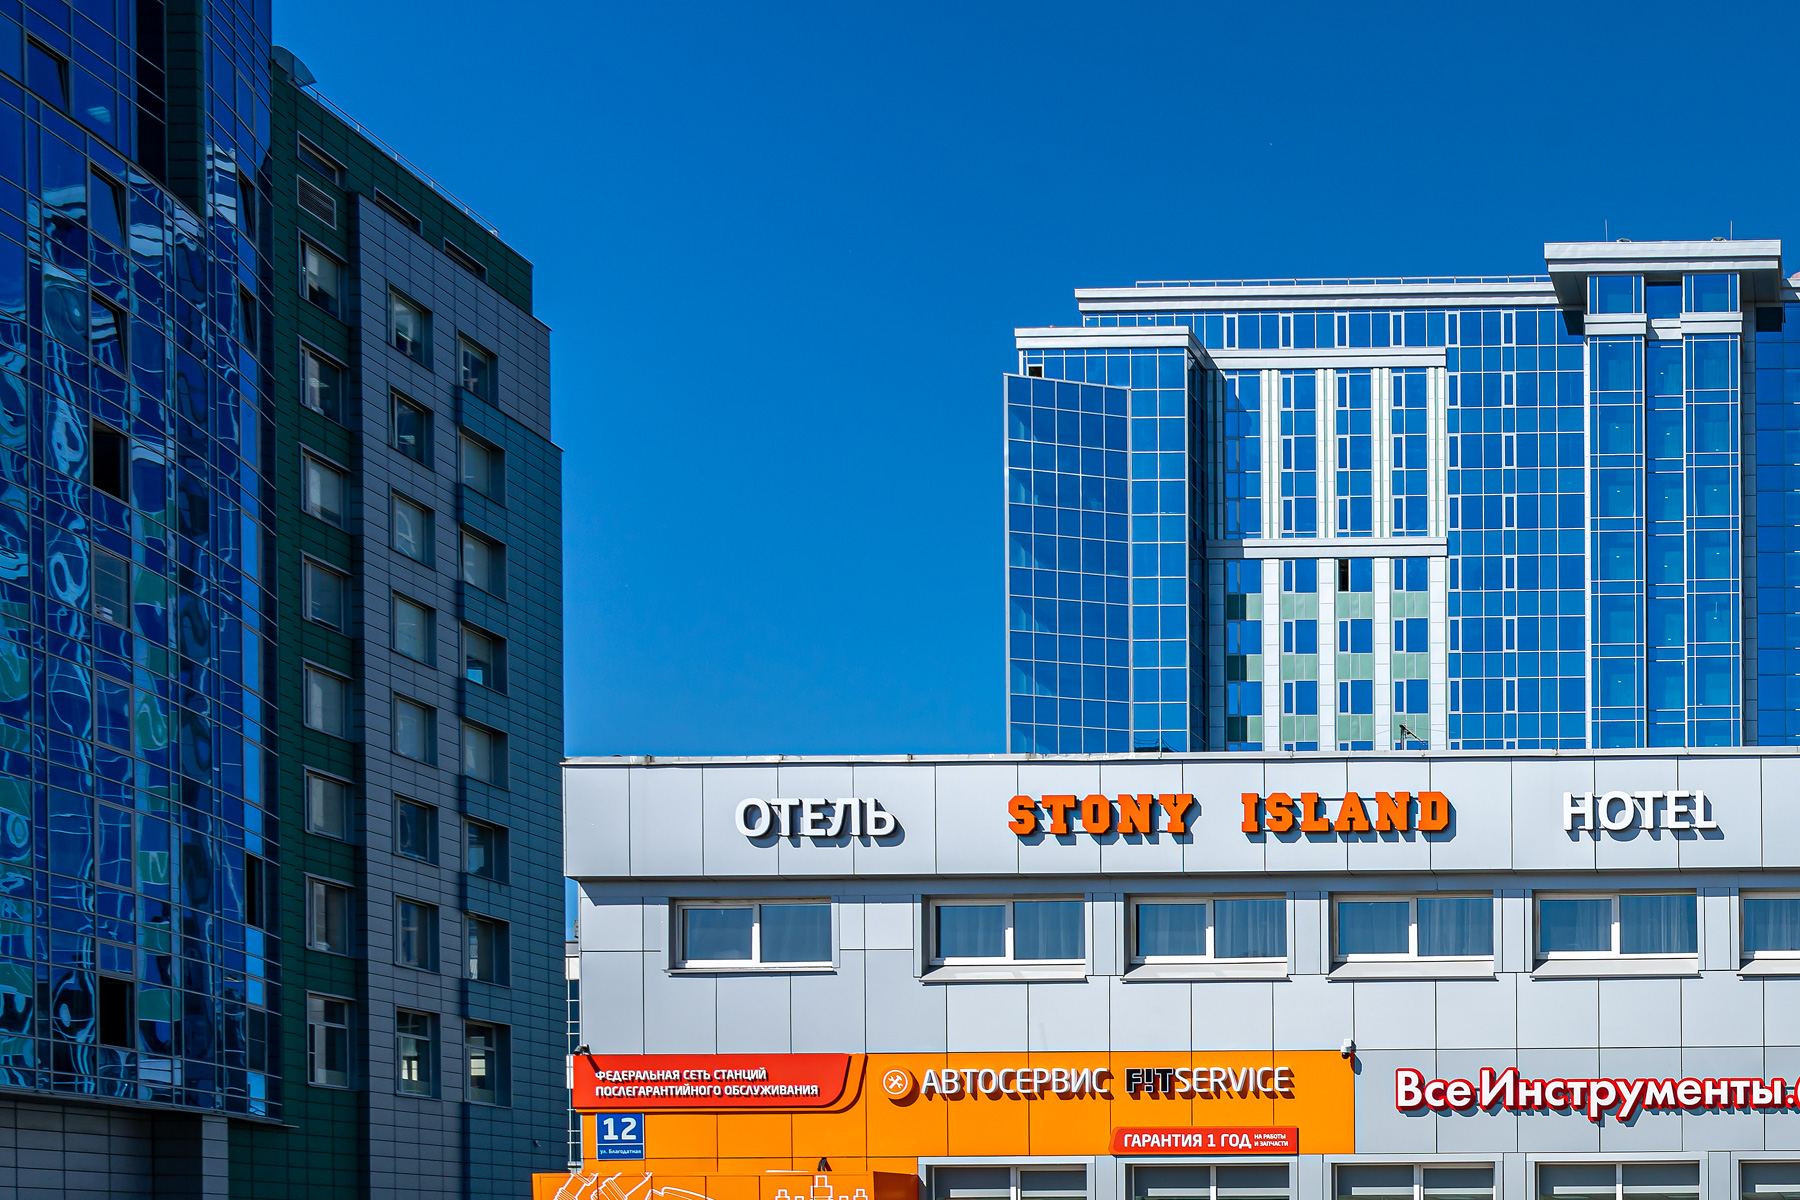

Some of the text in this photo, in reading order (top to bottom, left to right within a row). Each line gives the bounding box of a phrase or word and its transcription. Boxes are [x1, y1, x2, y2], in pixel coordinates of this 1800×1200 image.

[734, 797, 898, 838] ОТЕЛЬ
[1008, 791, 1452, 836] STONY ISLAND
[1562, 790, 1718, 831] HOTEL
[595, 1067, 767, 1081] ФЕДЕРАЛЬНАЯ СЕТЬ СТАНЦИЙ
[920, 1067, 1110, 1094] АВТОСЕРВИС
[595, 1083, 819, 1098] ПОСЛЕГАРАНТИЙНОГО ОБСЛУЖИВАНИЯ
[603, 1117, 637, 1140] 12
[608, 1148, 642, 1156] Благодатная
[1123, 1133, 1252, 1150] ГАРАНТИЯ 1 ГОД
